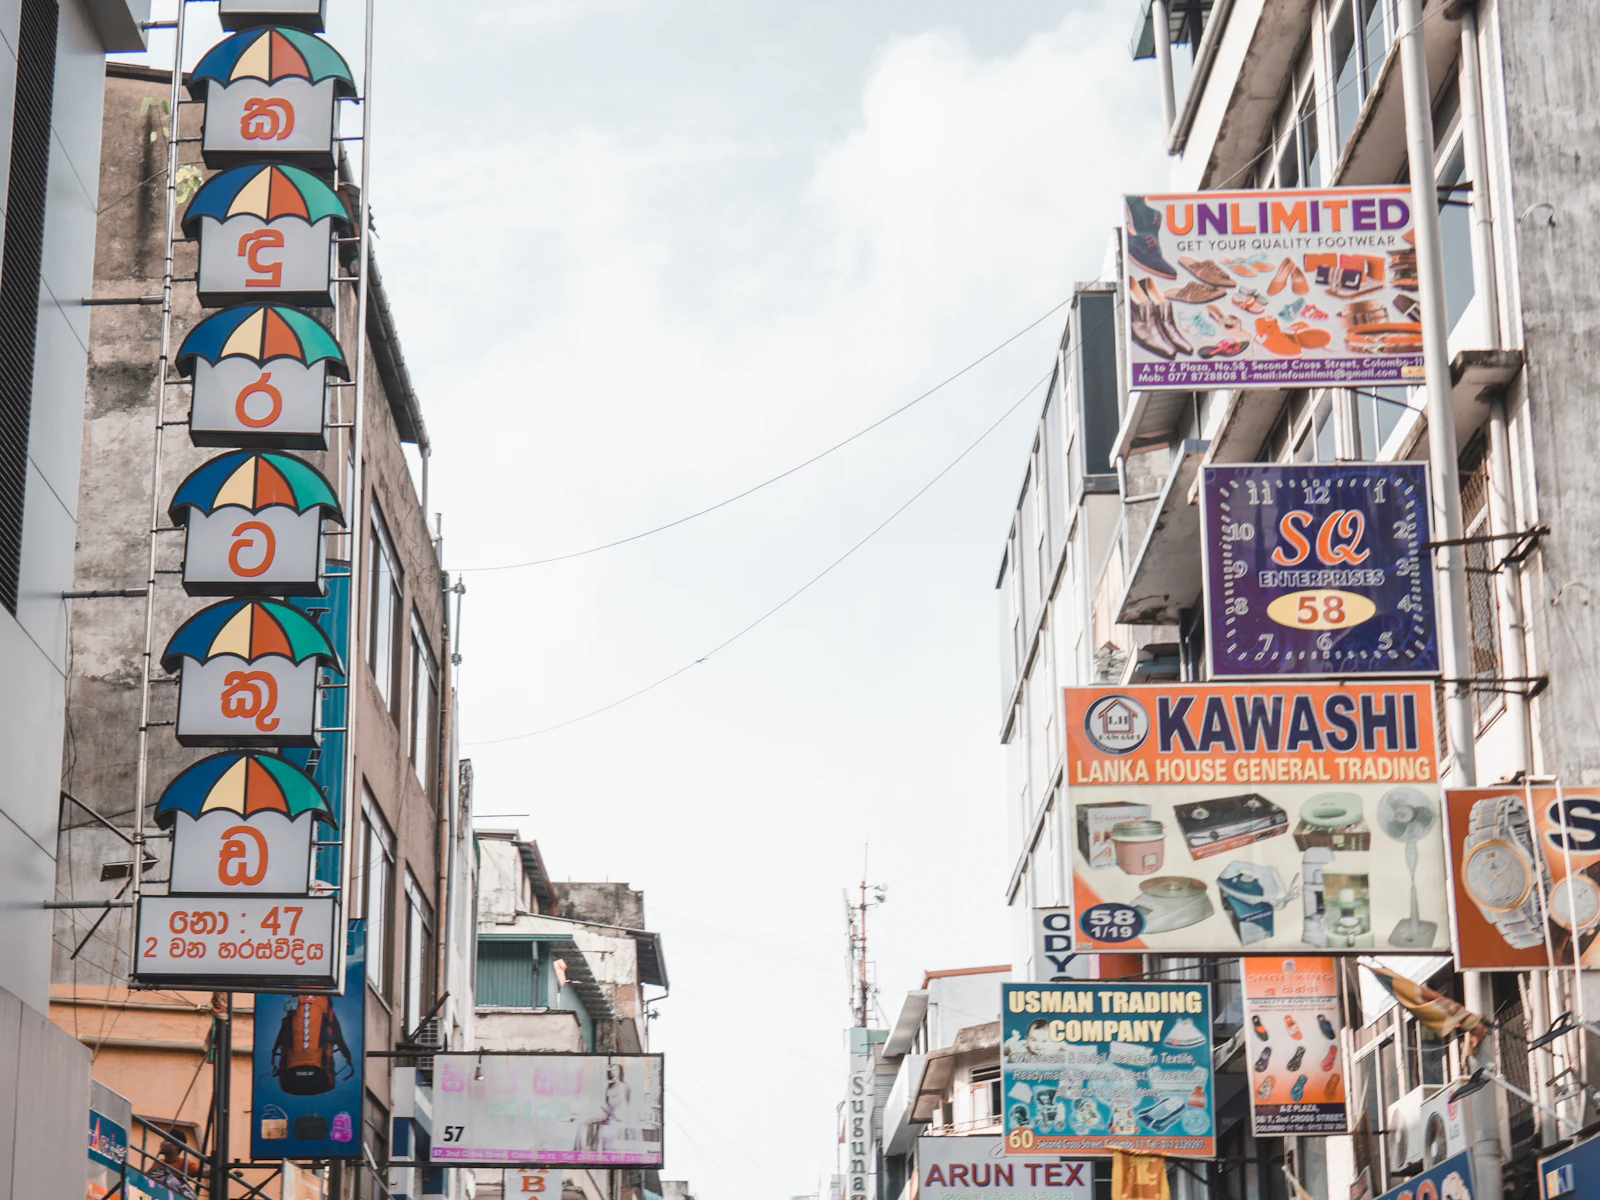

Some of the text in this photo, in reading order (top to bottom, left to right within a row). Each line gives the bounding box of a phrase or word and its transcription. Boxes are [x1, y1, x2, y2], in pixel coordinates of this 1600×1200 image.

[1165, 198, 1411, 236] UNLIMITED
[1177, 234, 1396, 251] GET YOUR QUALITY FOOTWEAR
[1142, 363, 1151, 373] A
[1154, 364, 1166, 373] to
[1169, 362, 1176, 372] Z
[1180, 362, 1211, 373] Plaza,
[1251, 361, 1288, 371] Second
[1291, 360, 1321, 370] Cross
[1325, 358, 1360, 370] Street,
[1138, 372, 1165, 382] Mob:
[1168, 371, 1187, 381] 077
[1249, 487, 1273, 505] 11
[1304, 486, 1330, 504] 12
[1374, 486, 1386, 504] 1
[1271, 509, 1370, 566] SQ
[1393, 521, 1408, 539] 2
[1233, 560, 1248, 578] 9
[1396, 558, 1409, 576] 3
[1259, 569, 1386, 588] ENTERPRISES
[1234, 597, 1249, 615] 8
[1297, 595, 1346, 624] 58
[1397, 594, 1413, 612] 4
[1258, 633, 1275, 652] 7
[1316, 632, 1333, 650] 6
[1378, 631, 1393, 650] 5
[1155, 692, 1421, 754] KAWASHI
[1076, 755, 1431, 784] LANKA HOUSE GENERAL TRADING
[260, 906, 303, 936] 47
[1089, 910, 1137, 926] 58
[1091, 926, 1133, 938] 1/19
[143, 936, 158, 958] 2
[169, 937, 206, 958] වන
[1008, 990, 1203, 1014] USMAN TRADING
[1049, 1019, 1164, 1043] COMPANY
[1160, 1051, 1196, 1066] Textile,
[443, 1126, 464, 1142] 57
[850, 1076, 866, 1191] Suguna
[1009, 1127, 1034, 1150] 60
[924, 1163, 1085, 1188] ARUN TEX
